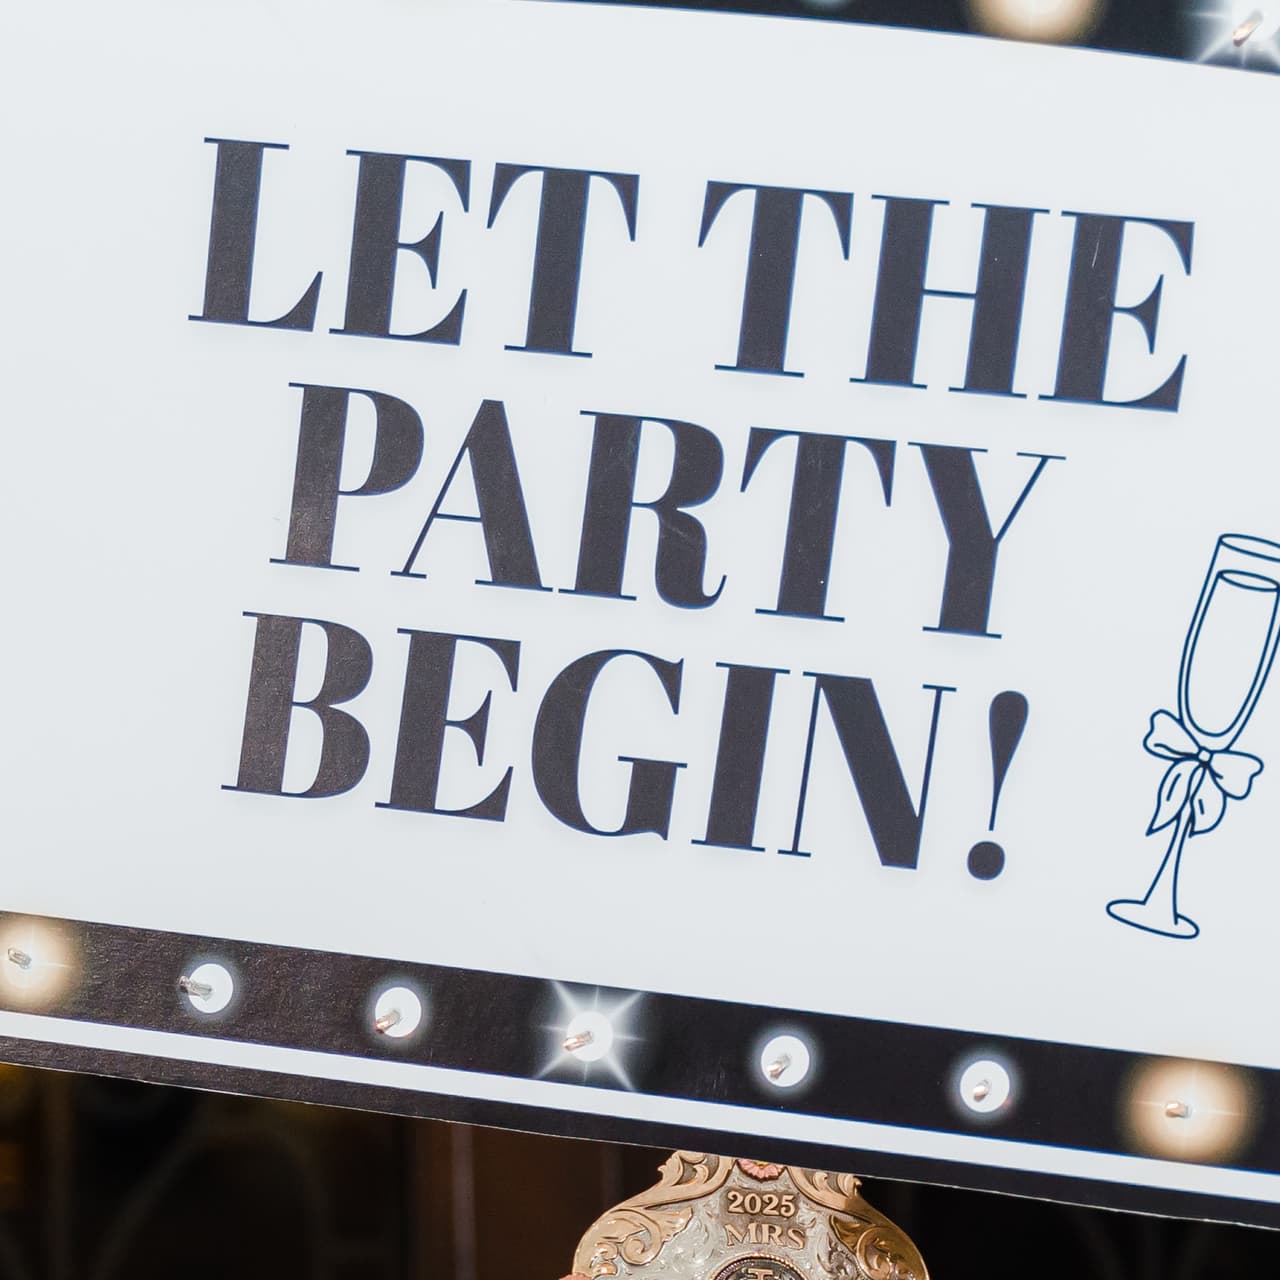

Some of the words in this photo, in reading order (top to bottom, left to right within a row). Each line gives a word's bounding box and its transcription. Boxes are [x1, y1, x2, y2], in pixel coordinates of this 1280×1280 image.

[188, 137, 640, 358] LET
[697, 179, 1195, 413] THE
[270, 381, 1066, 639] PARTY
[221, 611, 1030, 881] BEGIN!
[724, 1221, 806, 1251] MRS
[726, 1188, 797, 1218] 2025
